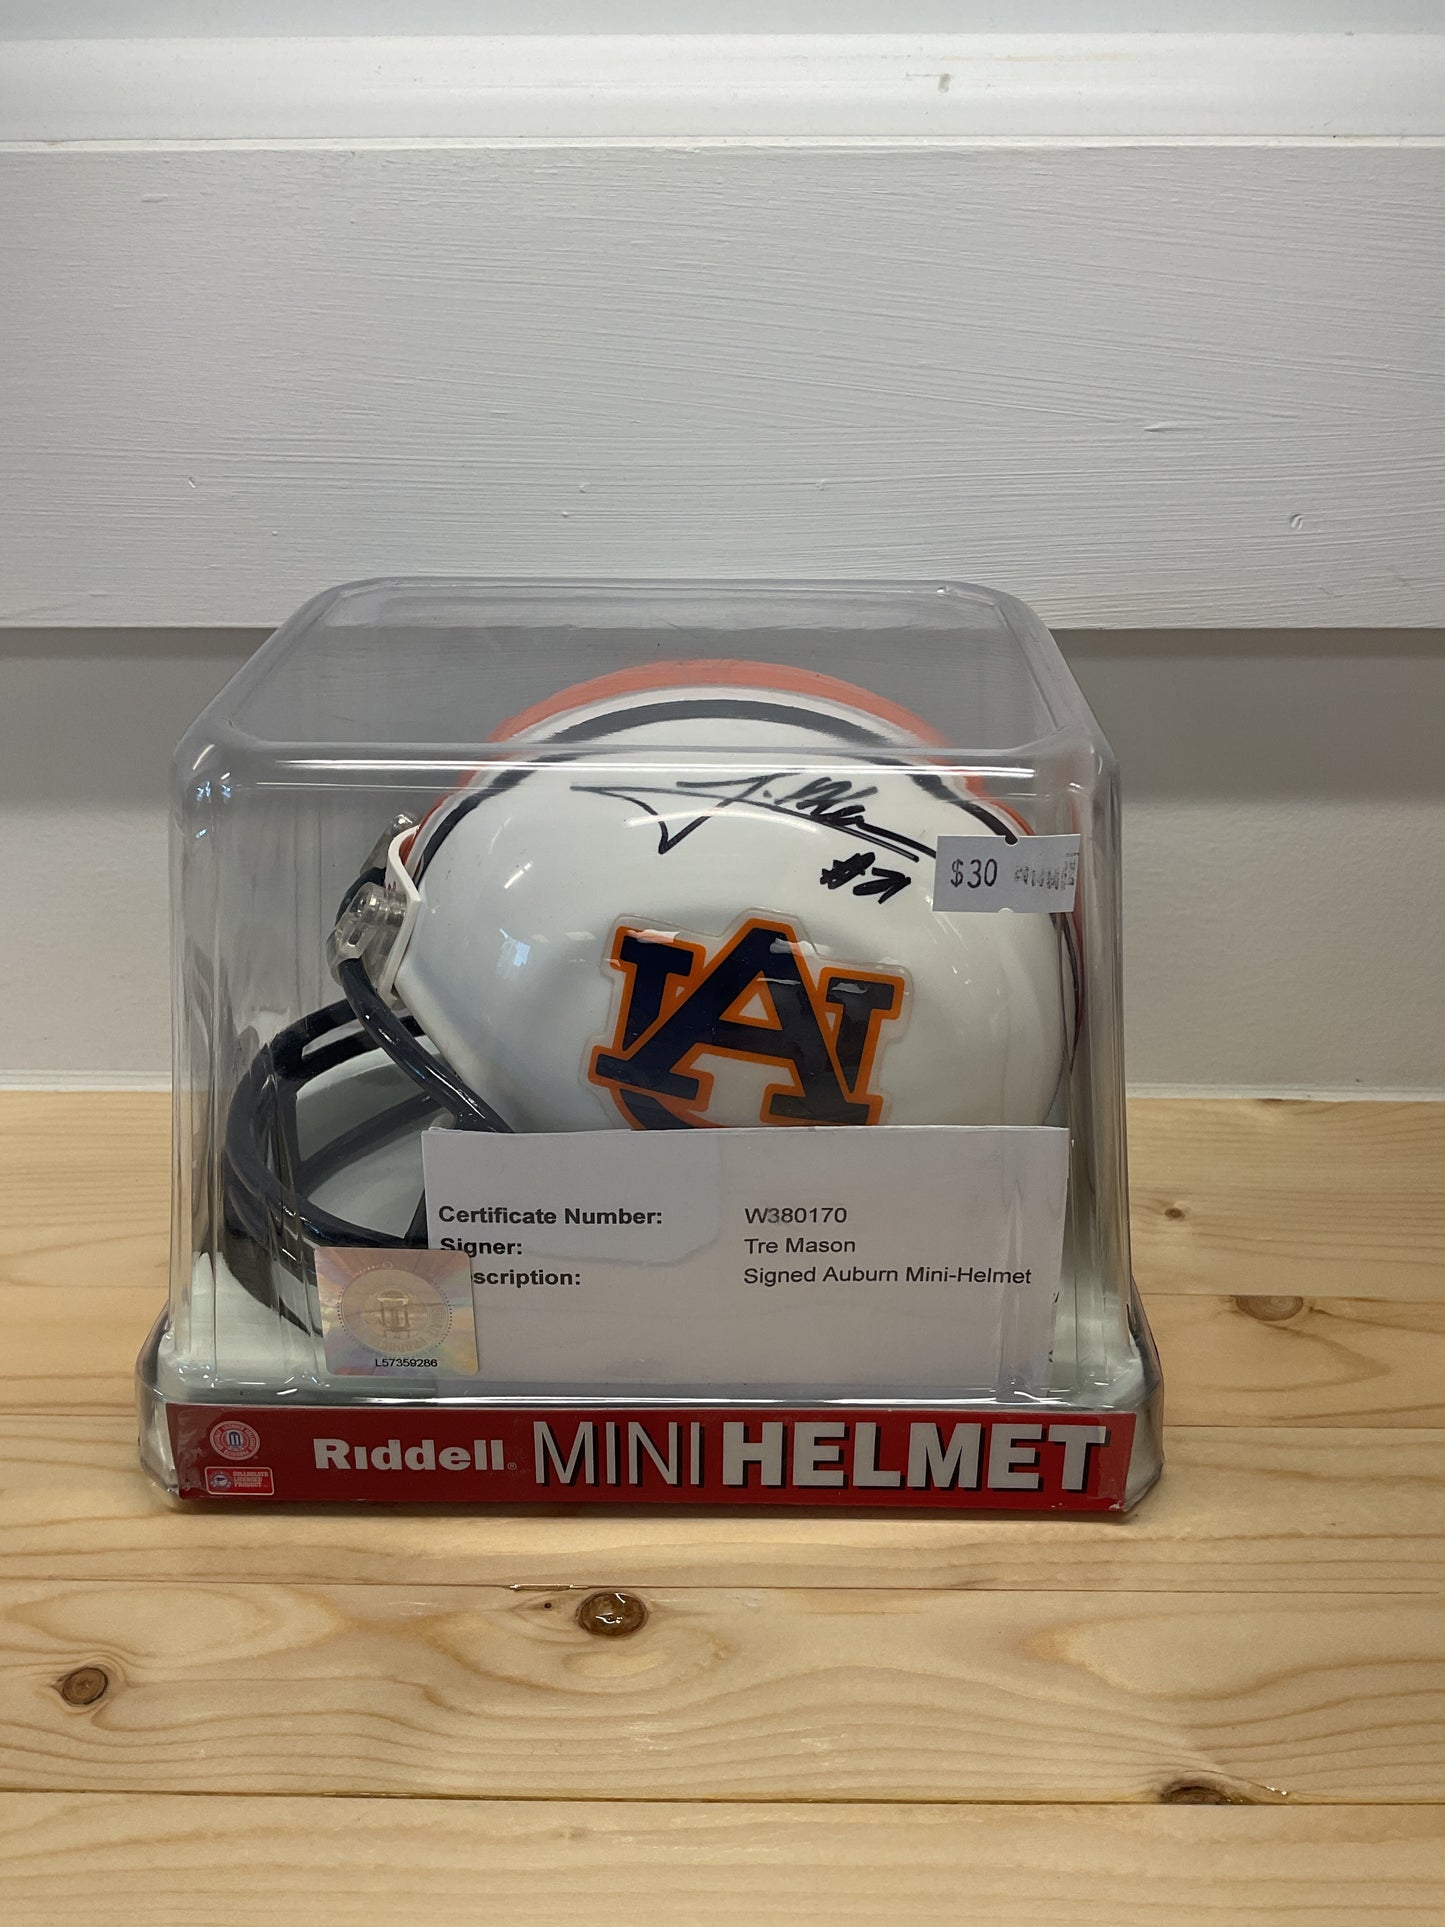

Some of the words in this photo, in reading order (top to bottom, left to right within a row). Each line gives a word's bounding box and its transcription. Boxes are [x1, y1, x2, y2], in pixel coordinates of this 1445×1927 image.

[950, 858, 998, 888] $30
[438, 1205, 557, 1225] Certificate
[564, 1207, 663, 1225] Number:
[744, 1207, 848, 1224] W380170
[440, 1237, 523, 1258] Signer:
[744, 1238, 779, 1254] Tre
[785, 1237, 856, 1253] Mason
[470, 1269, 581, 1289] scription:
[743, 1266, 817, 1287] Signed
[822, 1266, 899, 1283] Auburn
[905, 1266, 1032, 1284] Mini-Helmet
[375, 1358, 438, 1367] L57359286
[533, 1421, 703, 1487] MINI
[722, 1421, 1108, 1491] HELMET
